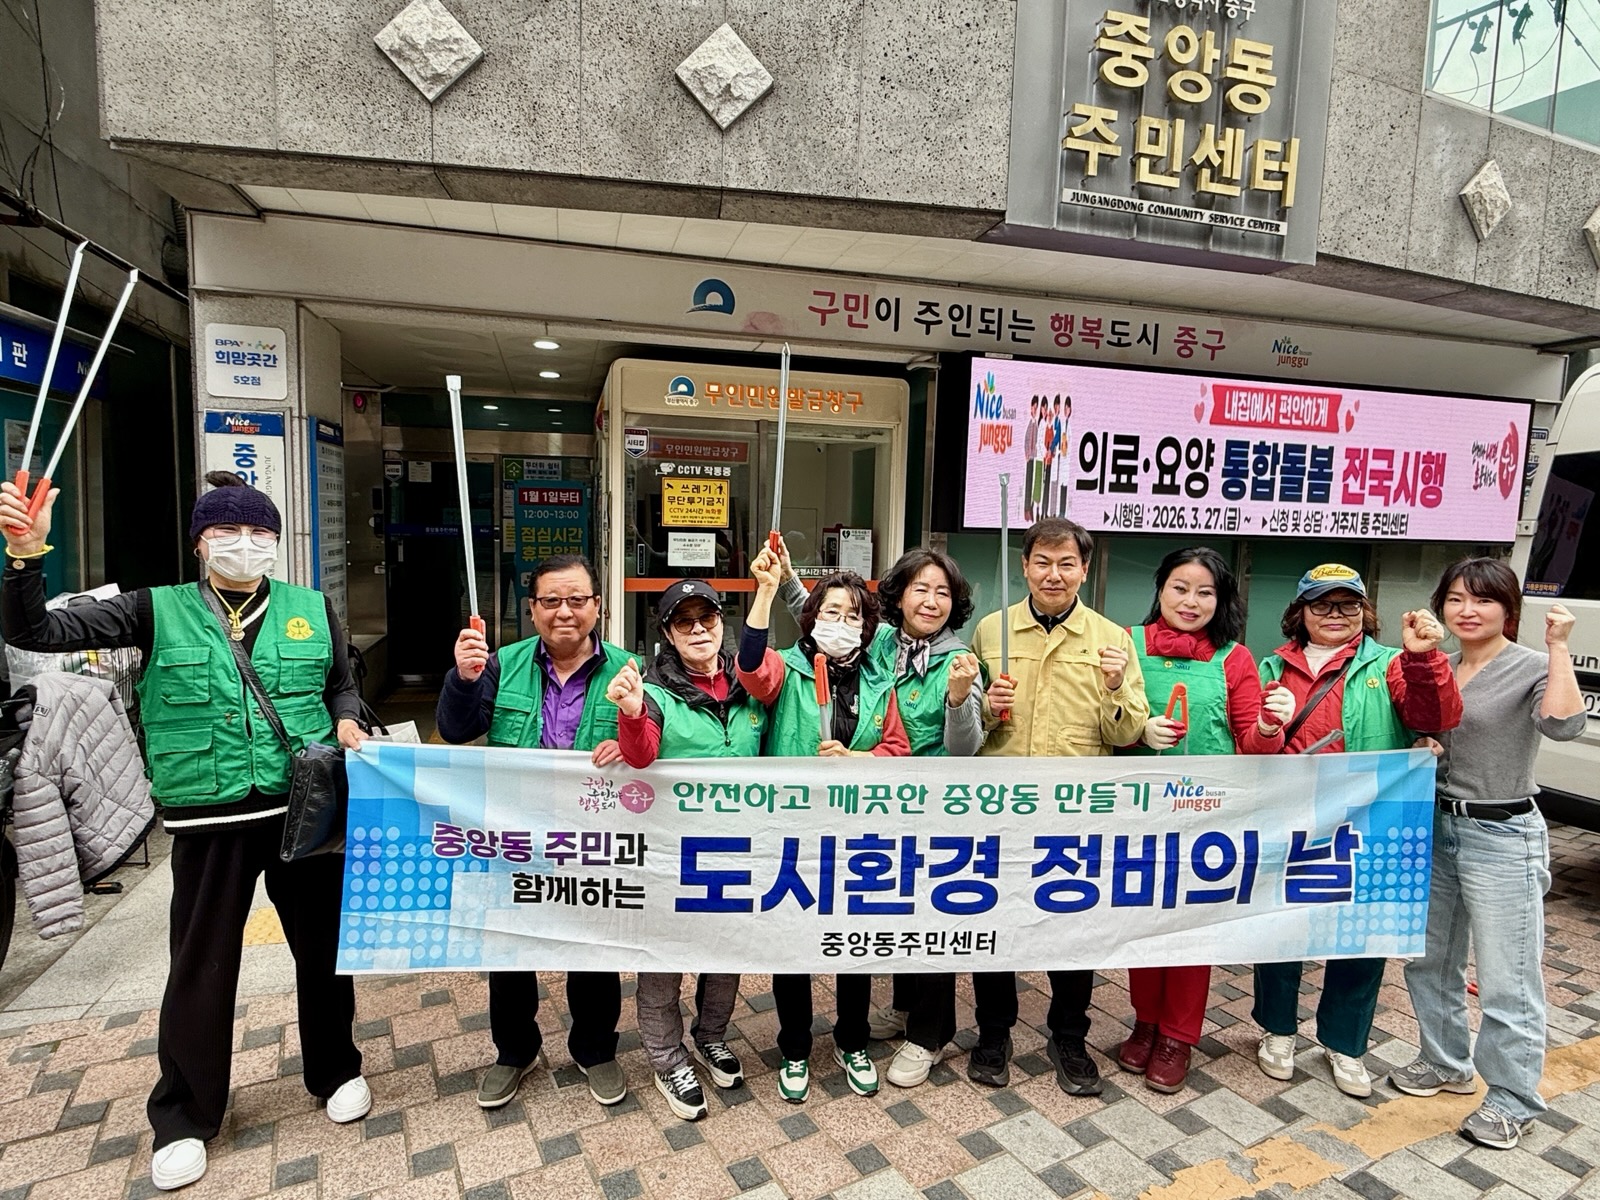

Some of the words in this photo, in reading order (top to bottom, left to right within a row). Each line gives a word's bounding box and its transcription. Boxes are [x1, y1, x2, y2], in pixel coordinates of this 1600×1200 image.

[1095, 10, 1277, 114] 중앙동
[1062, 103, 1300, 208] 주민센터
[1070, 191, 1144, 213] JUNGANGDONG
[1147, 203, 1206, 221] COMMUNITY
[1209, 213, 1245, 228] SERVICE
[1247, 219, 1280, 233] CENTER
[808, 290, 900, 332] 구민이
[913, 301, 1035, 344] 주인되는
[1050, 313, 1160, 355] 행복도시
[1173, 326, 1226, 361] 중구
[215, 339, 241, 347] BPA
[1271, 339, 1299, 355] Nice
[215, 350, 278, 368] 희망곳간
[1276, 355, 1309, 368] junggu
[233, 375, 261, 386] 5호점
[703, 381, 864, 414] 무인민원발급창구
[973, 383, 1003, 420] Nice
[1002, 406, 1017, 420] busan
[1224, 390, 1277, 424] 내집에서
[1279, 393, 1329, 428] 편안하게
[225, 416, 250, 426] Nice
[231, 425, 260, 434] junggu
[978, 422, 1013, 454] junggu
[665, 443, 739, 458] 무인민원발급창구
[677, 465, 701, 475] CCTV
[704, 466, 731, 476] 작동중
[1076, 431, 1215, 498] 의료·요양
[1221, 439, 1335, 504] 통합돌봄
[1341, 447, 1447, 509] 전국시행
[523, 491, 539, 503] 1월
[542, 491, 580, 503] 1일부터
[681, 484, 711, 494] 쓰레기
[667, 495, 724, 506] 무단투기금지
[523, 509, 579, 519] 12:00~13:00
[1110, 503, 1145, 529] 시행일
[1152, 505, 1188, 529] 2026.
[1269, 509, 1290, 533] 신청
[1291, 511, 1301, 534] 및
[1303, 511, 1325, 534] 상담
[1329, 512, 1358, 535] 거주지
[1372, 512, 1409, 536] 주민센터
[521, 527, 583, 543] 점심시간
[580, 777, 613, 789] 구민이
[1163, 781, 1205, 798] Nice
[1205, 789, 1226, 797] busan
[587, 788, 622, 801] 주인되는
[624, 786, 654, 808] 중구
[672, 781, 812, 814] 안전하고
[827, 783, 929, 815] 깨끗한
[942, 783, 1040, 815] 중앙동
[1054, 782, 1150, 815] 만들기
[578, 796, 616, 813] 행복도시
[1171, 798, 1222, 813] junggu
[432, 822, 533, 863] 중앙동
[544, 831, 649, 867] 주민과
[674, 833, 1001, 916] 도시환경
[1031, 830, 1260, 914] 정비의
[1284, 823, 1360, 904] 날
[512, 871, 646, 910] 함께하는
[820, 930, 997, 958] 중앙동주민센터
